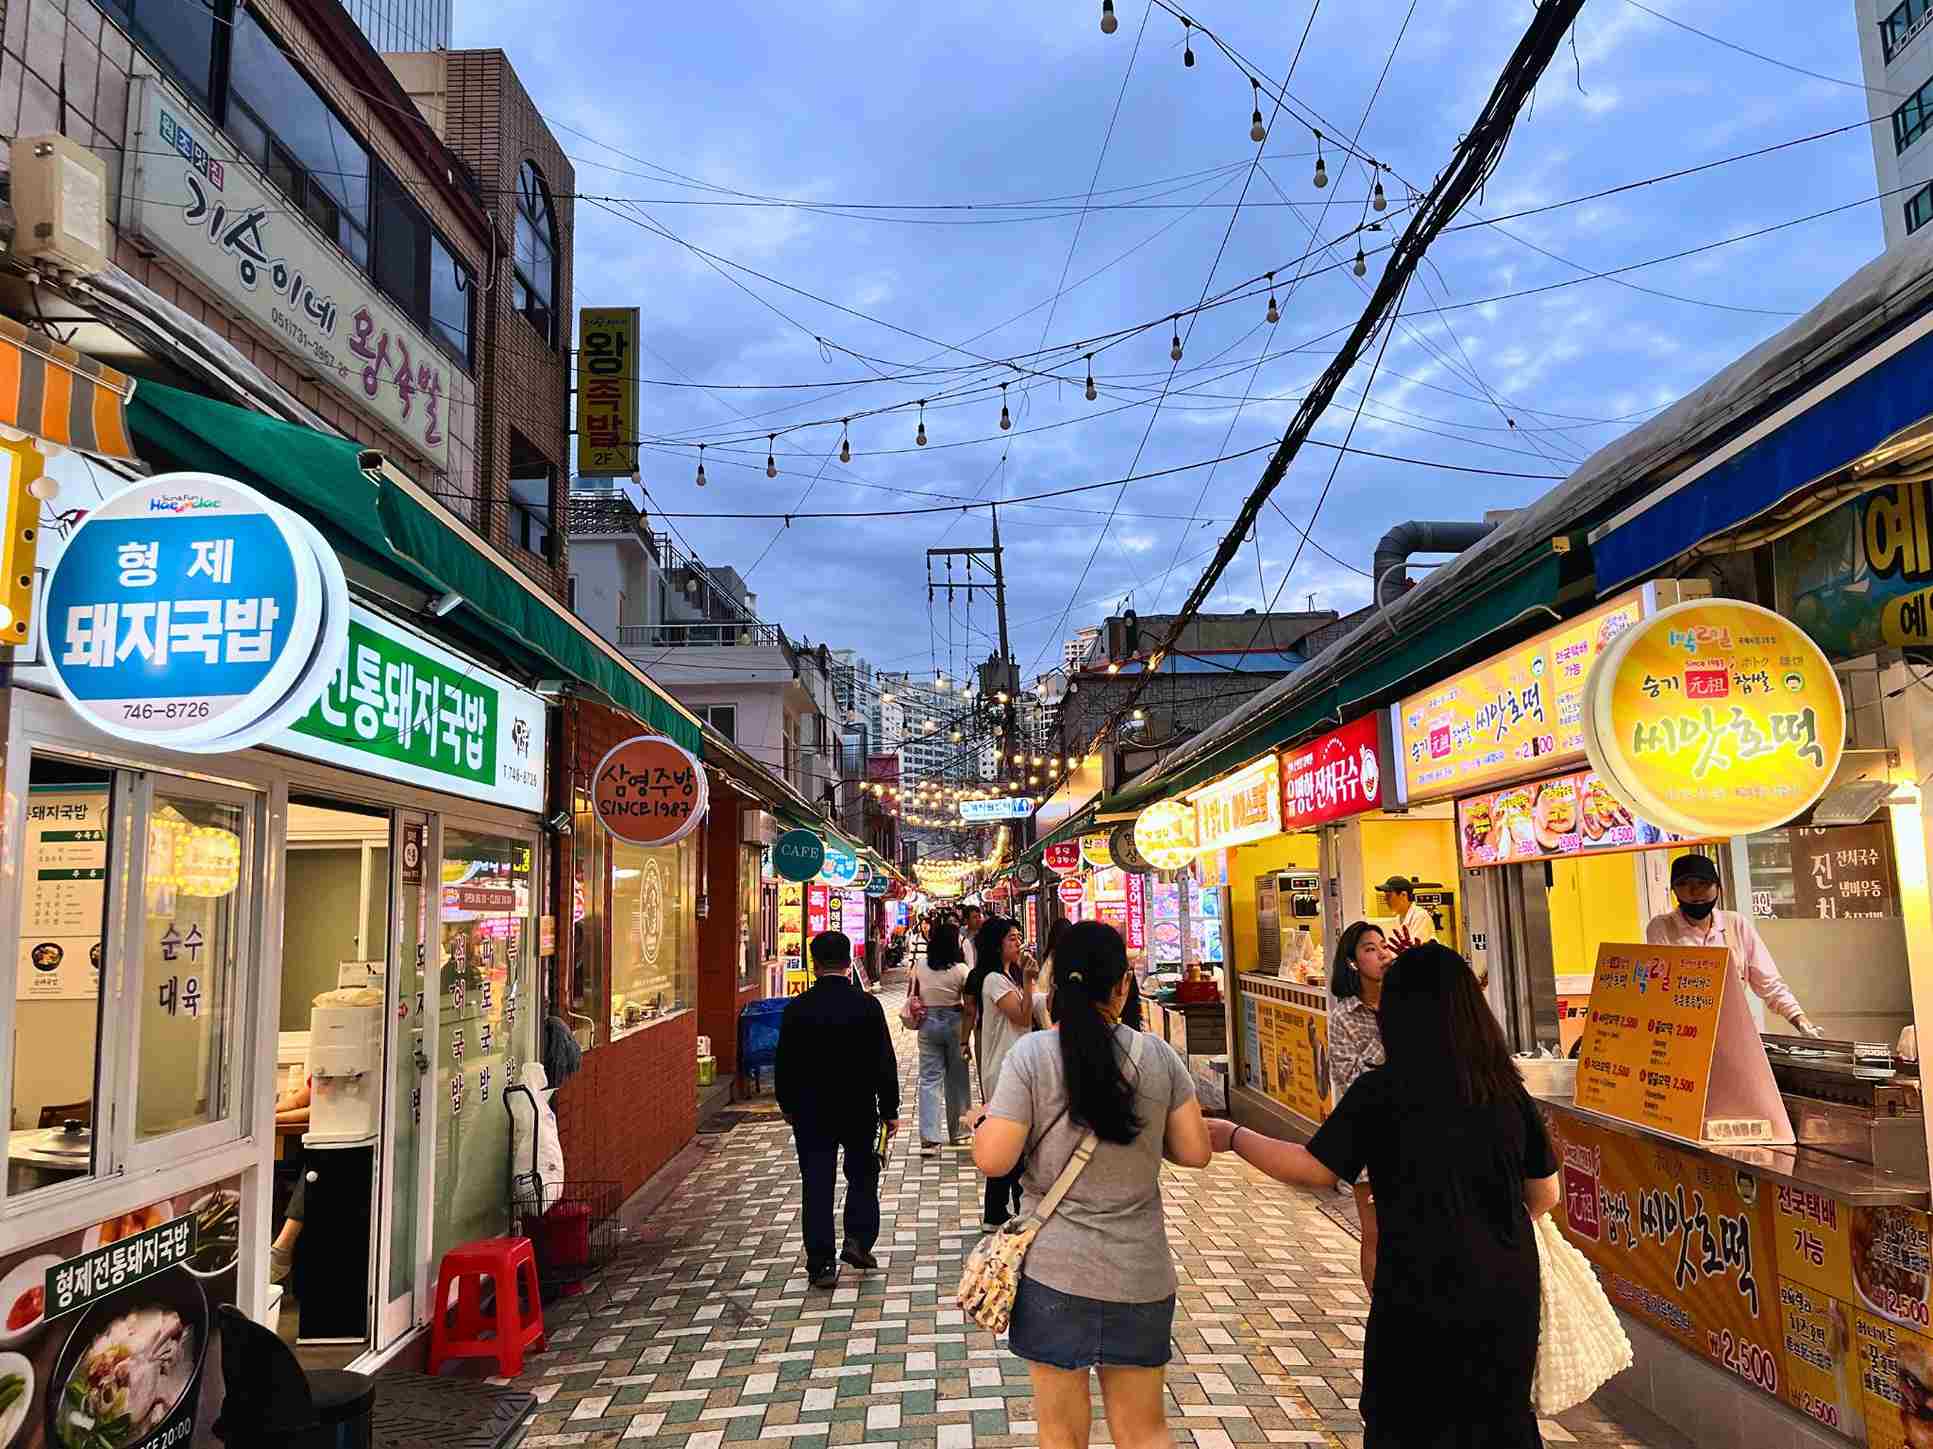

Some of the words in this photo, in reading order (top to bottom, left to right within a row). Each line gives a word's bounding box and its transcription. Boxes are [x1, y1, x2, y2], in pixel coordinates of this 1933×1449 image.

[349, 305, 442, 444] 왕족발
[583, 331, 628, 449] 왕족발
[593, 453, 614, 465] 2F
[117, 541, 160, 588] 형
[186, 538, 235, 585] 제
[62, 597, 280, 668] 돼지국밥
[1642, 674, 1679, 698] 승기
[1688, 676, 1729, 695] 元祖
[1732, 671, 1775, 694] 찹쌀
[123, 702, 210, 720] 746-8726
[1475, 681, 1544, 743] 씨앗호떡
[1633, 707, 1824, 778] 씨앗호떡
[601, 763, 694, 798] 삼영주방
[600, 800, 650, 816] SINCE
[654, 801, 692, 817] 1987
[1608, 827, 1634, 843] 2,500
[780, 843, 819, 860] CAFE
[1675, 1023, 1698, 1039] 2,000
[1672, 1076, 1695, 1093] 2,500
[1778, 1186, 1837, 1232] 전국택배
[1638, 1183, 1759, 1317] 씨앗호떡
[1793, 1230, 1824, 1266] 가능
[56, 1221, 189, 1308] 형제전통돼지국밥
[162, 1417, 191, 1447] 20:00
